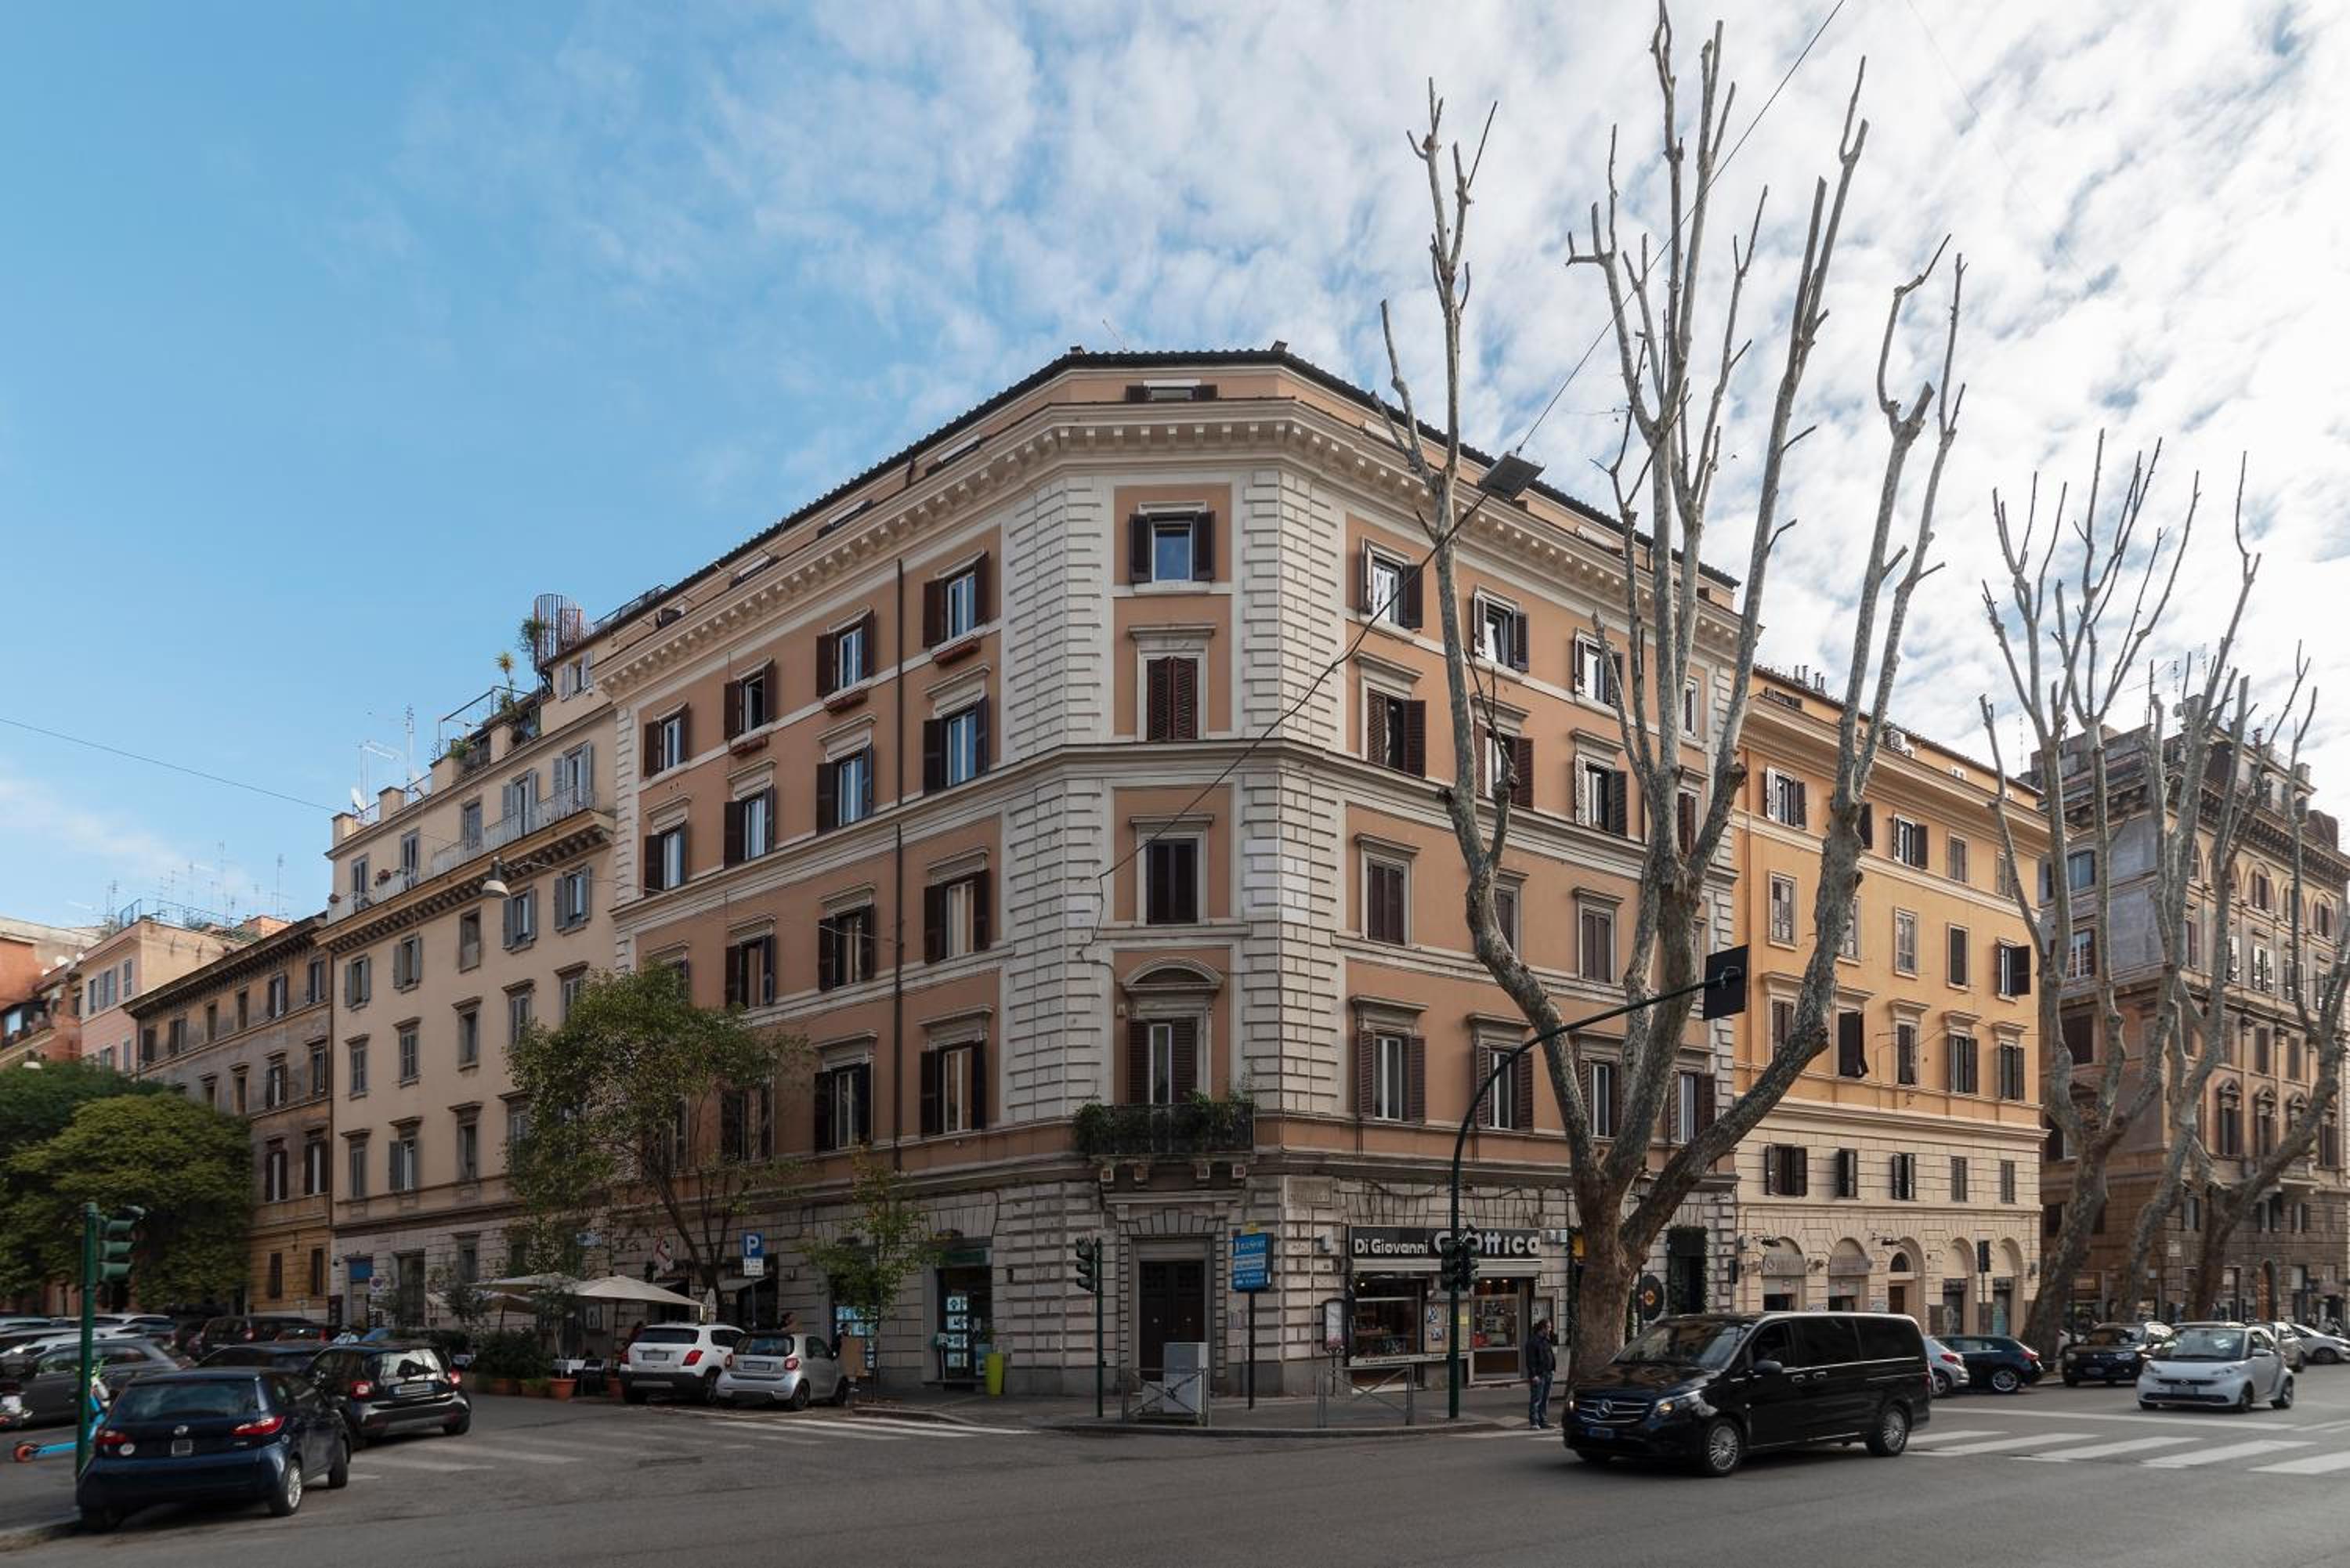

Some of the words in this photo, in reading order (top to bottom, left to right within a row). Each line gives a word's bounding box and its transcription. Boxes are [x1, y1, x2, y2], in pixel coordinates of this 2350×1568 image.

[747, 1235, 759, 1256] P
[1354, 1238, 1368, 1254] Di
[1371, 1238, 1429, 1254] Giovanni
